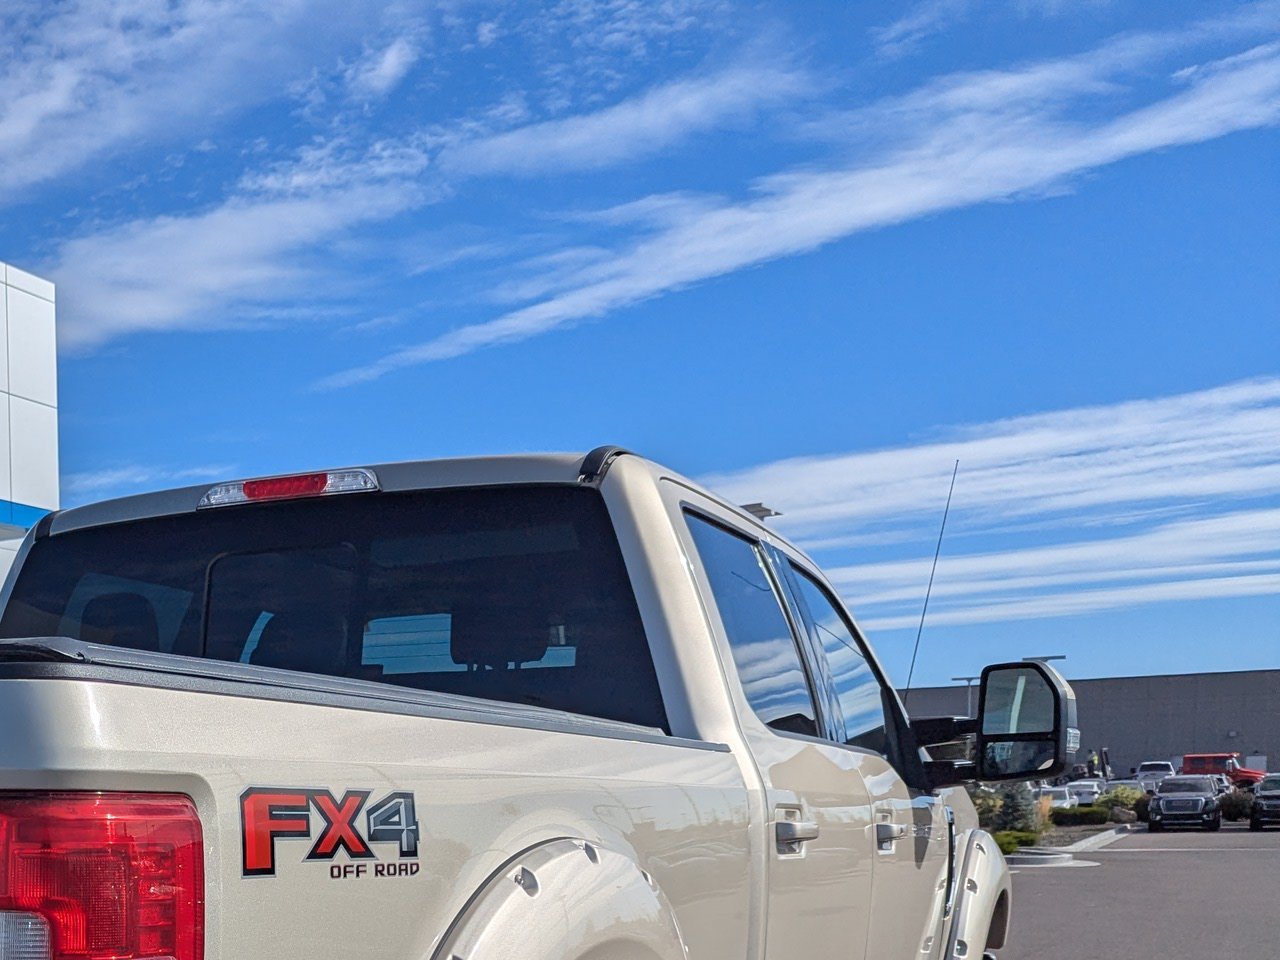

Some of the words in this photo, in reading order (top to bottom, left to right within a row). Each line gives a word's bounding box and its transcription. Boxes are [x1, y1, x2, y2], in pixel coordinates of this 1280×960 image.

[238, 784, 420, 879] FX4
[330, 864, 368, 879] OFF
[374, 862, 420, 877] ROAD
